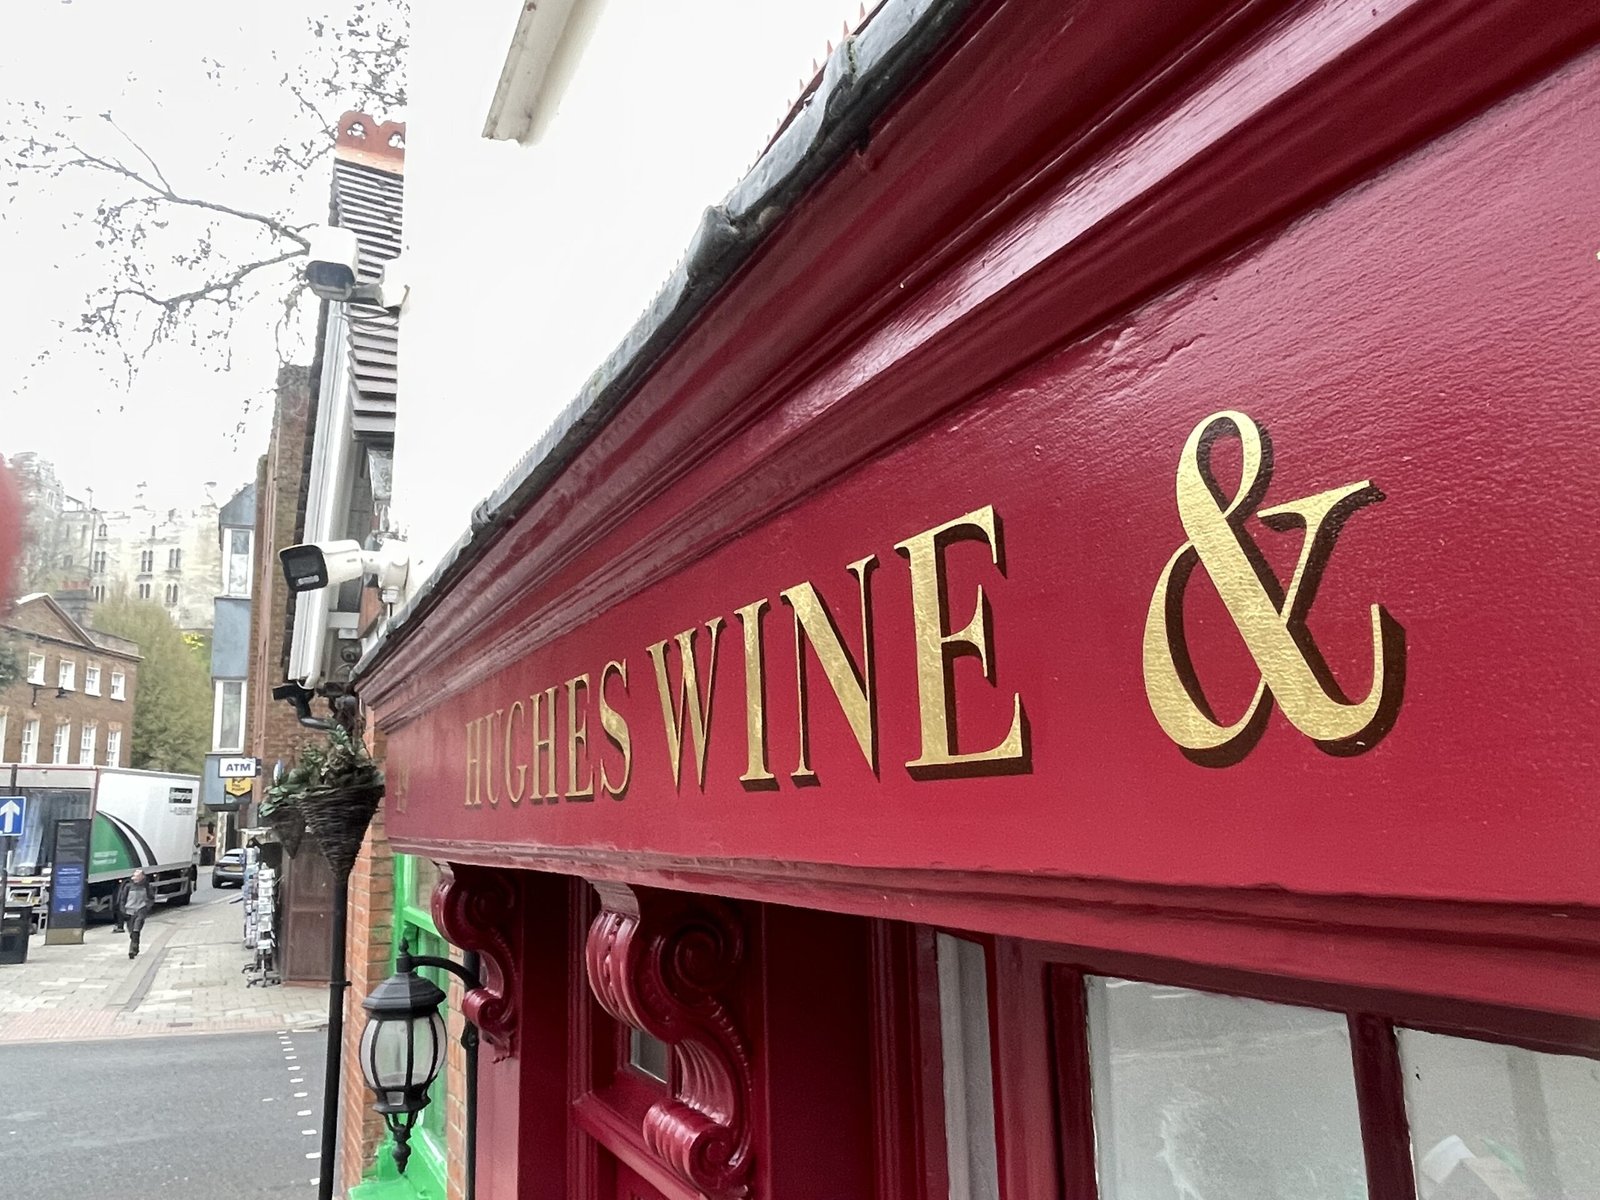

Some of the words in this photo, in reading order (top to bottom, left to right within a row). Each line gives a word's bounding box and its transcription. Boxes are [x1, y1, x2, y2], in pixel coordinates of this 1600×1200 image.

[464, 658, 633, 806] HUGHES
[645, 504, 1028, 792] WINE
[1143, 410, 1398, 762] &
[225, 763, 251, 772] ATM
